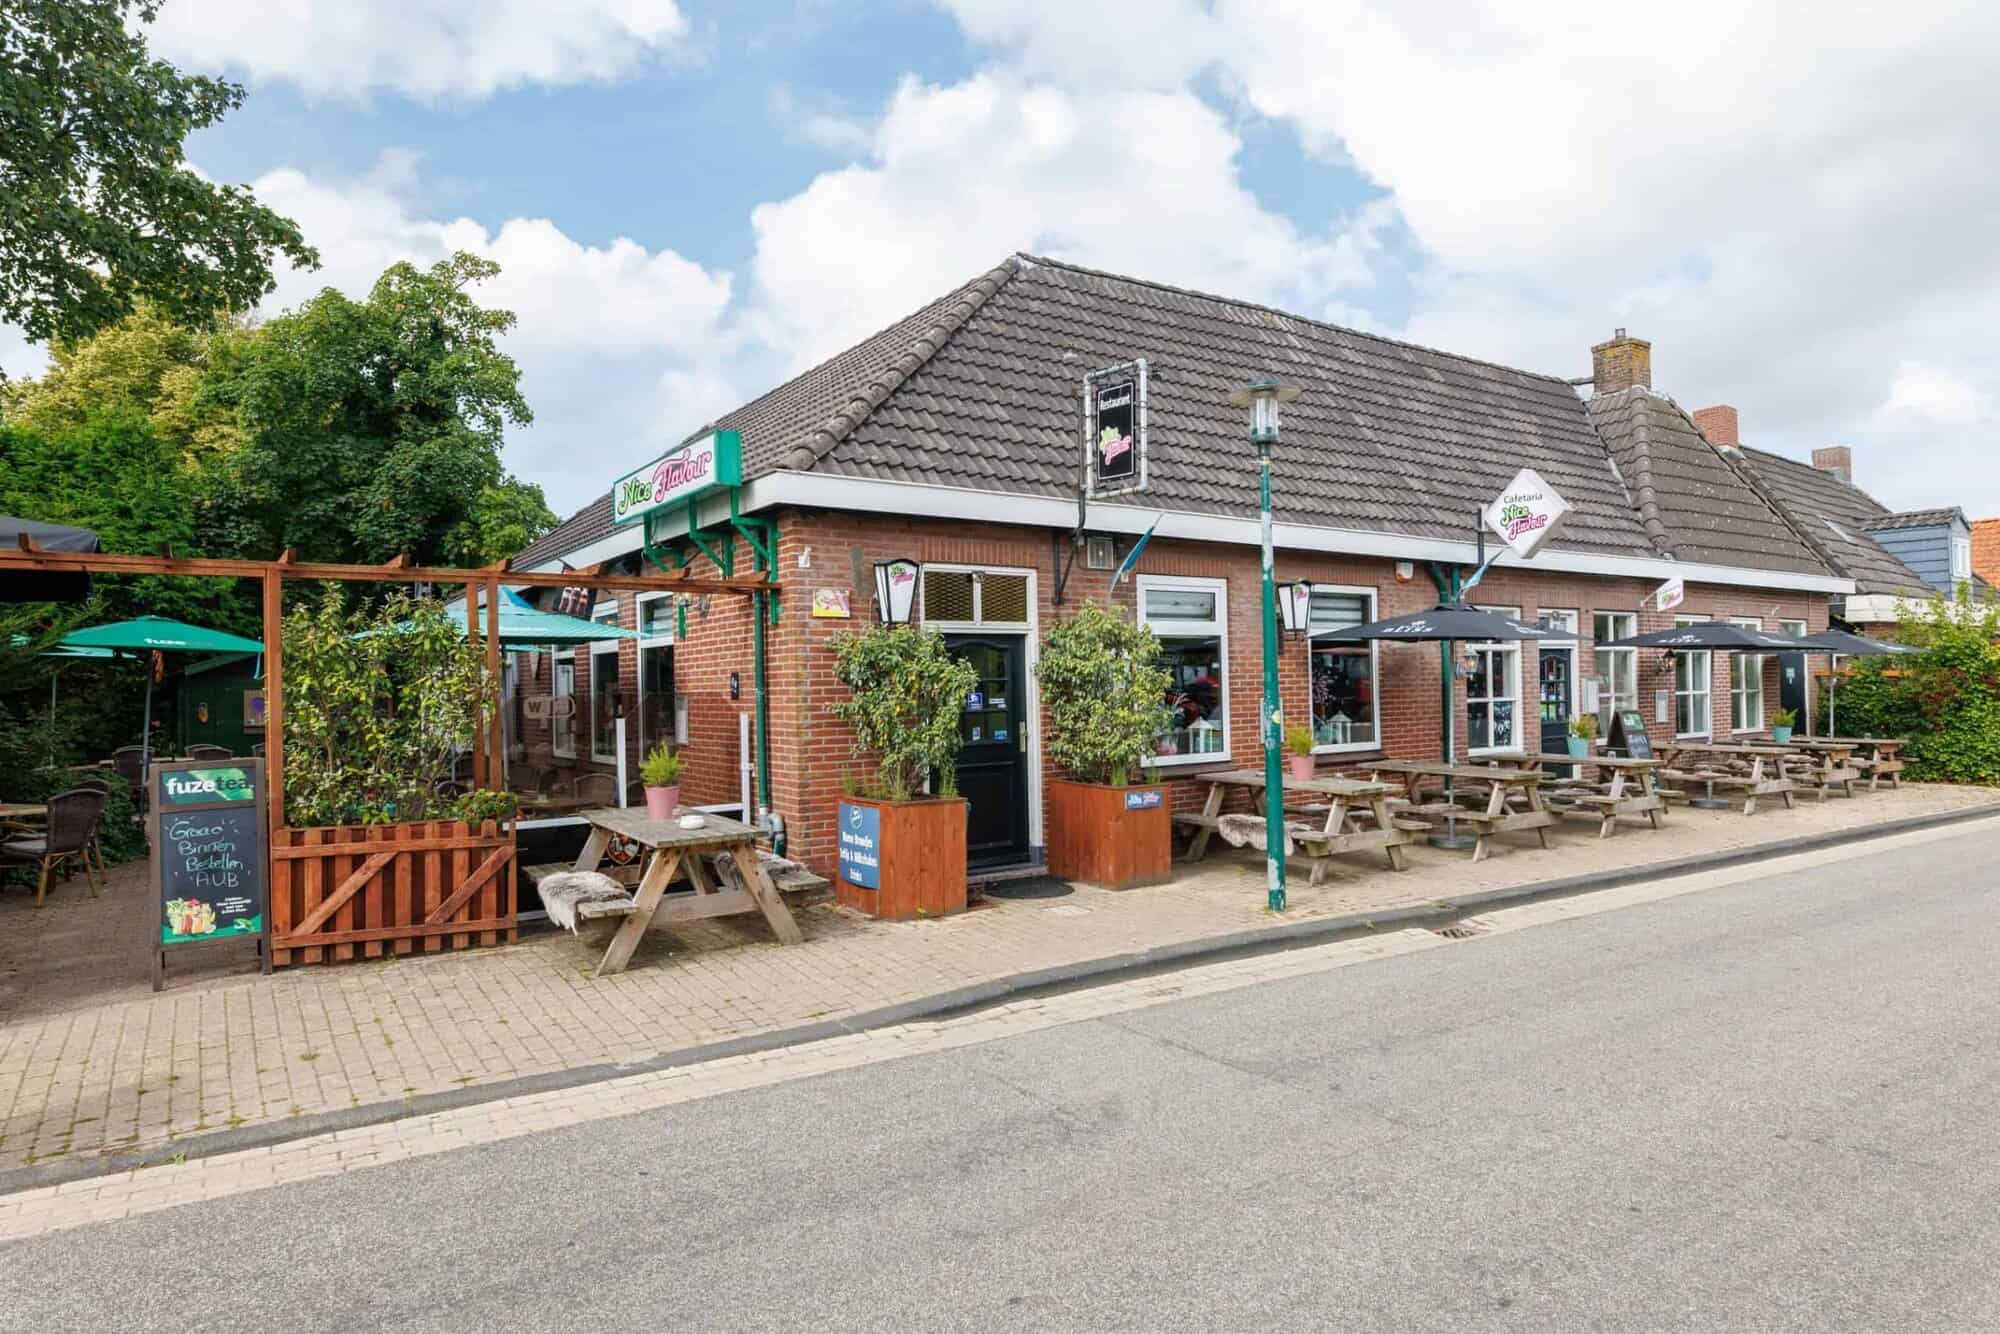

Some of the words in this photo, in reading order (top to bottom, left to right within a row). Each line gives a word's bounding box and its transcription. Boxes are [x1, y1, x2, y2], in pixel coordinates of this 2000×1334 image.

[617, 478, 653, 515] Nice
[652, 447, 712, 503] Flavour
[1503, 492, 1543, 504] Cafetaria
[1500, 504, 1529, 527] Nice
[1506, 512, 1548, 541] Flavour
